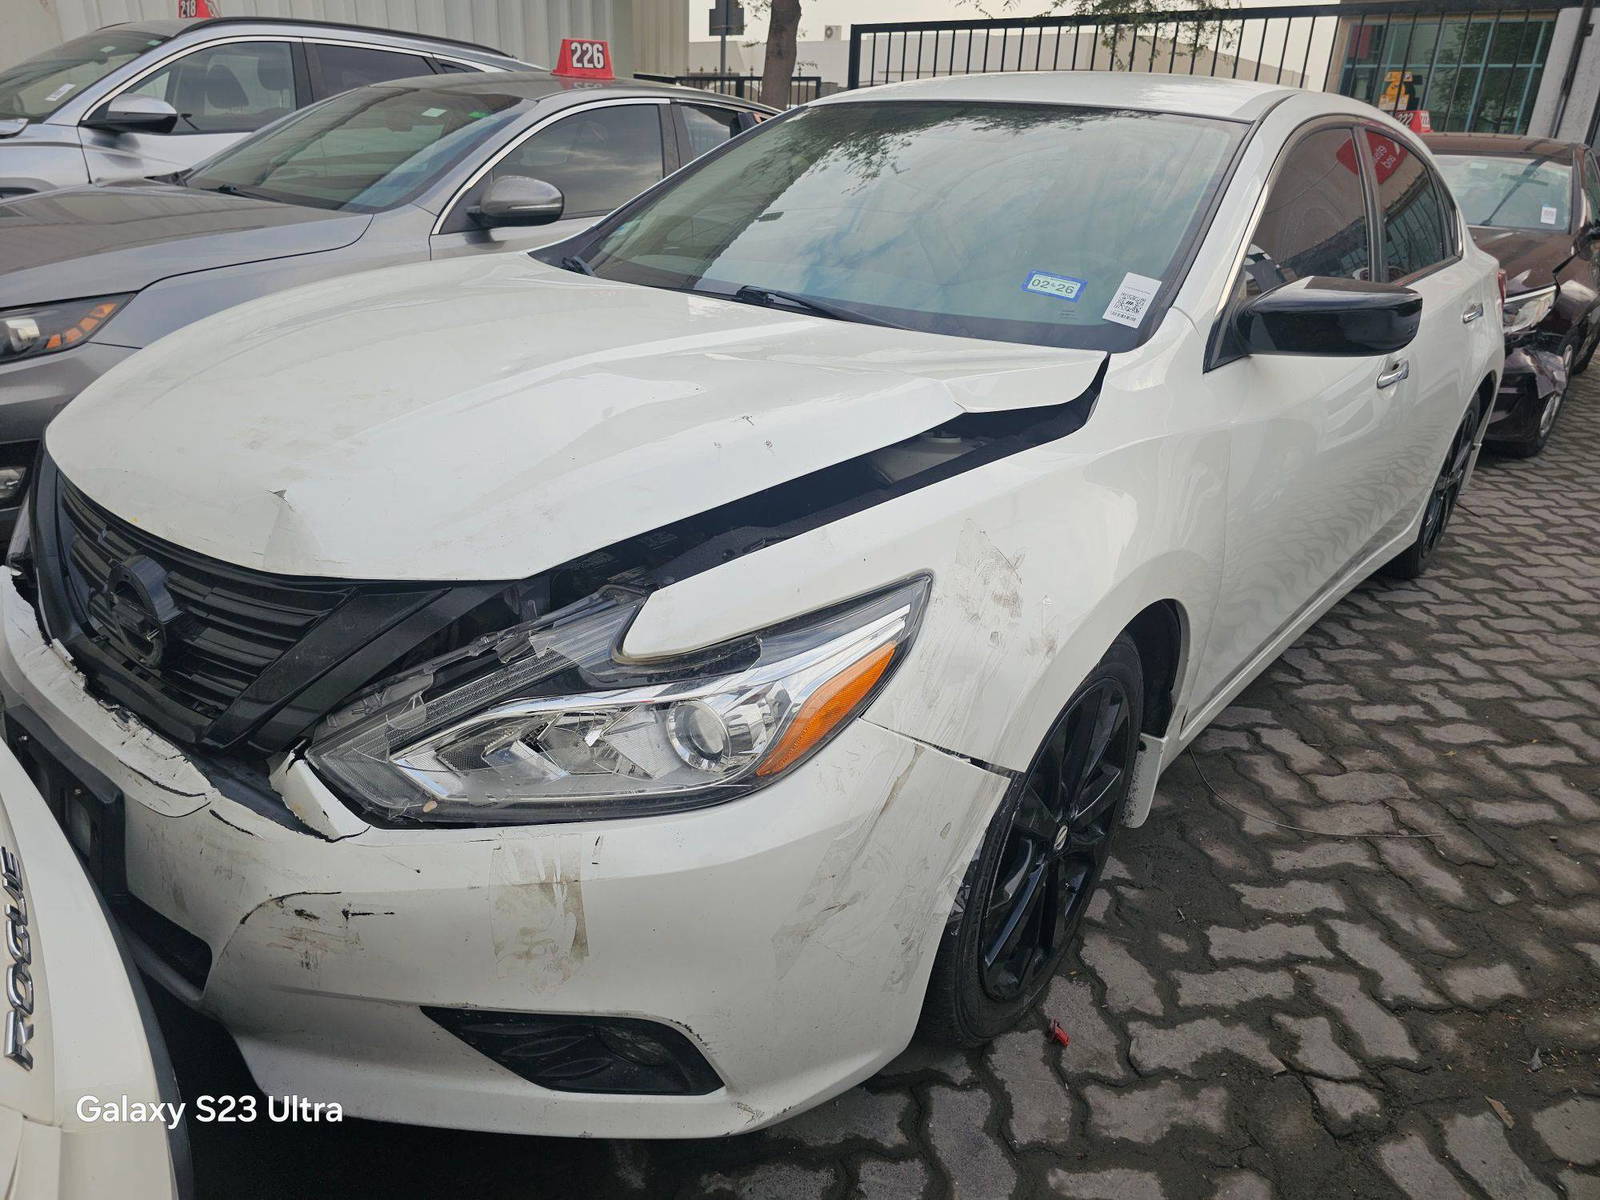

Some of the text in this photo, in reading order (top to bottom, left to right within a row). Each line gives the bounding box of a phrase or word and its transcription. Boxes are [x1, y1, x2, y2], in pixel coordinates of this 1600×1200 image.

[571, 42, 605, 69] 226
[1031, 278, 1075, 294] 02 26
[0, 846, 34, 1072] ROGUE
